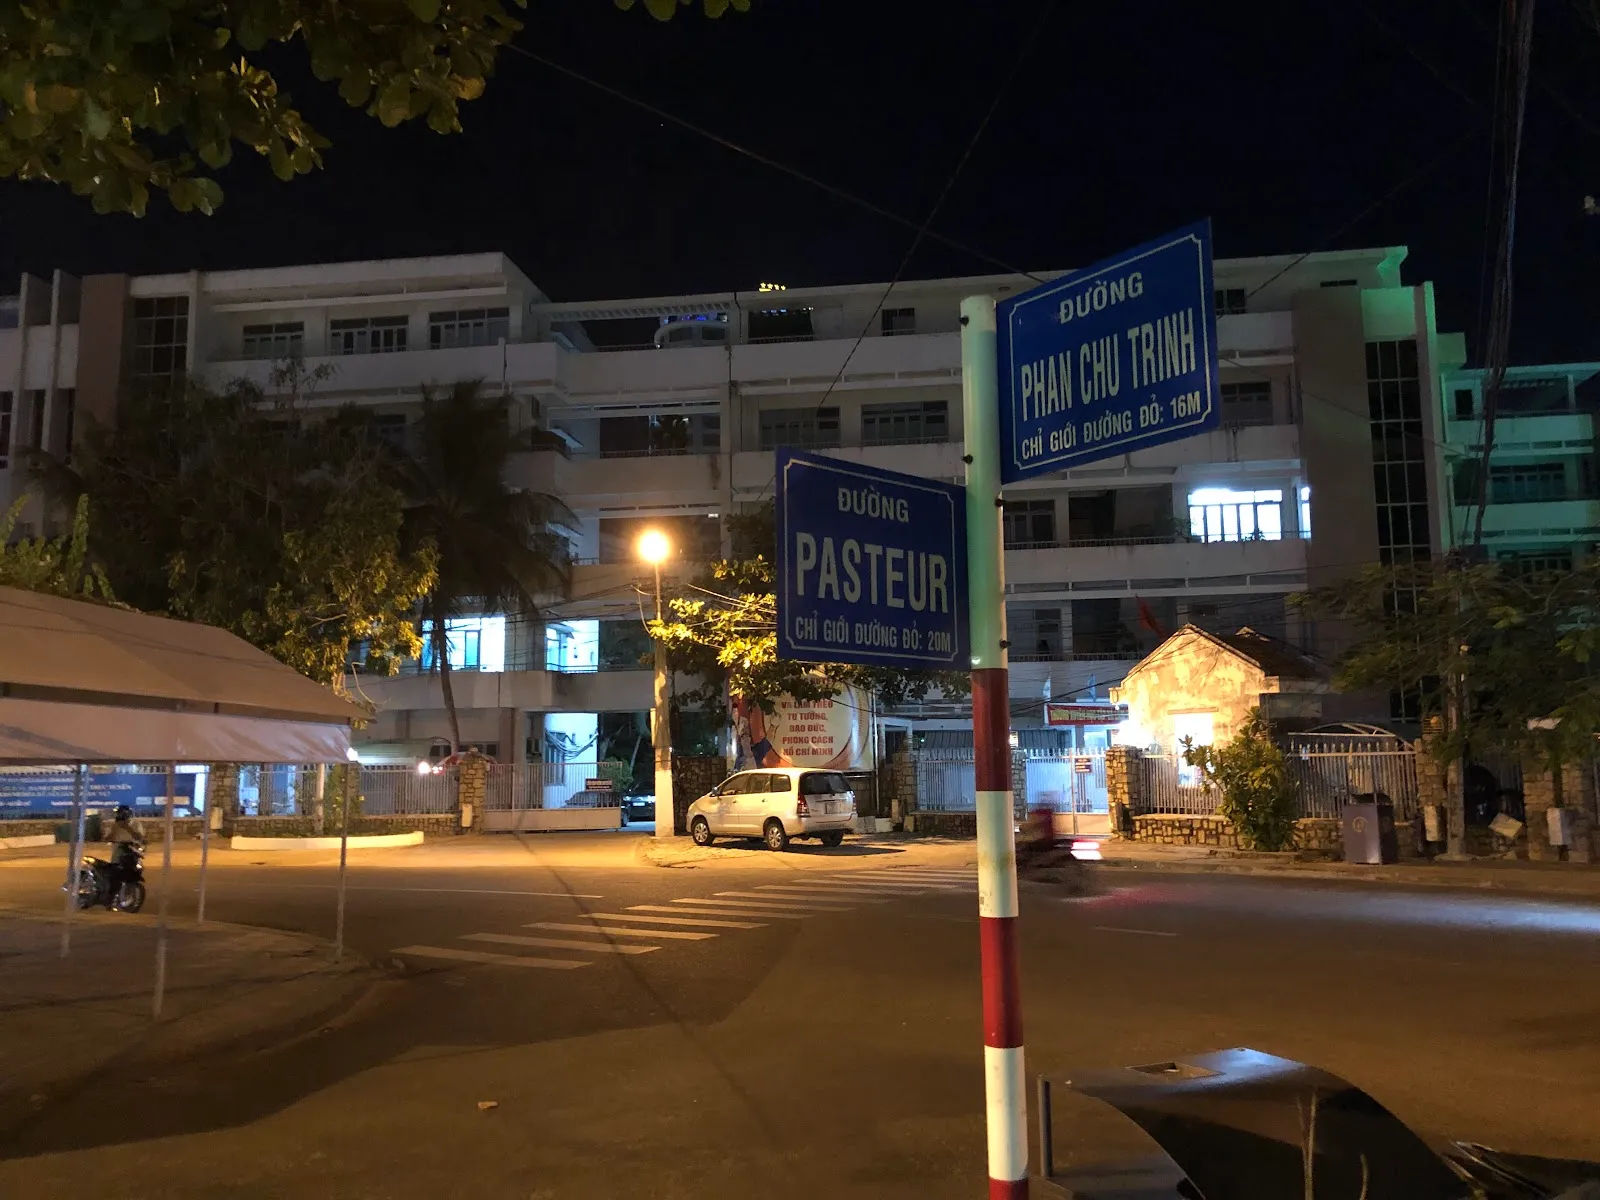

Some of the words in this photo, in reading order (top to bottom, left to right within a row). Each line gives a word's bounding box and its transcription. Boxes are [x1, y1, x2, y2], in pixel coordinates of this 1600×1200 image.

[1059, 271, 1144, 324] ĐƯỜNG
[1021, 351, 1073, 422] PHAN
[1079, 334, 1120, 405] CHU
[1127, 308, 1196, 389] TRINH
[1021, 427, 1043, 460] CHỈ
[1050, 421, 1077, 452] GIỚI
[1140, 393, 1163, 428] ĐỎ:
[1170, 390, 1200, 419] 16M
[838, 485, 909, 523] ĐƯỜNG
[796, 532, 949, 613] PASTEUR
[796, 610, 818, 641] CHỈ
[823, 615, 849, 643] GIỚI
[855, 619, 898, 648] ĐƯỜNG
[902, 620, 922, 650] ĐỎ:
[928, 630, 951, 653] 20M
[782, 736, 809, 744] PHONG
[812, 748, 833, 756] MINH
